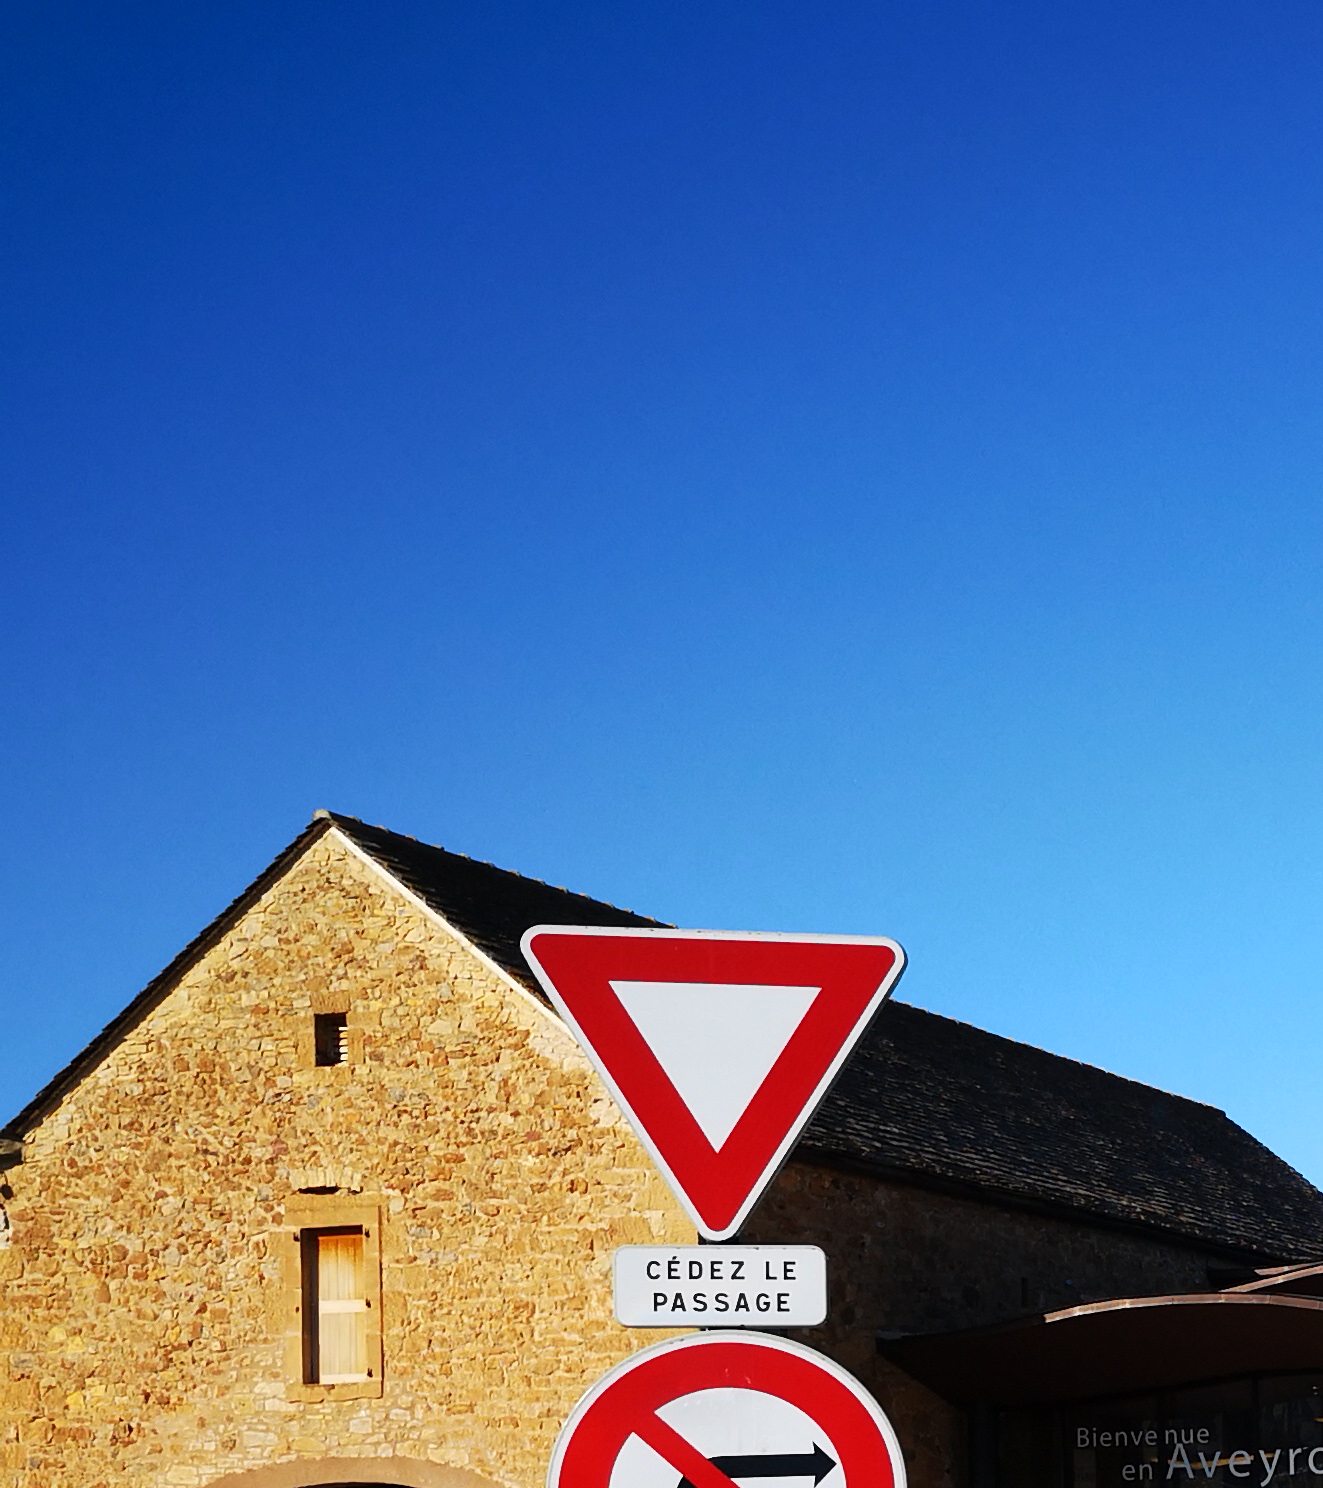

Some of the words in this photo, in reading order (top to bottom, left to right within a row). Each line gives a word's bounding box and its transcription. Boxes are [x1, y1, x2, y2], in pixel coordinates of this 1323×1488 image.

[646, 1256, 745, 1281] CÉDEZ
[765, 1260, 797, 1281] LE
[653, 1292, 791, 1312] PASSAGE
[1076, 1426, 1210, 1448] Bienvenue
[1121, 1462, 1153, 1482] en
